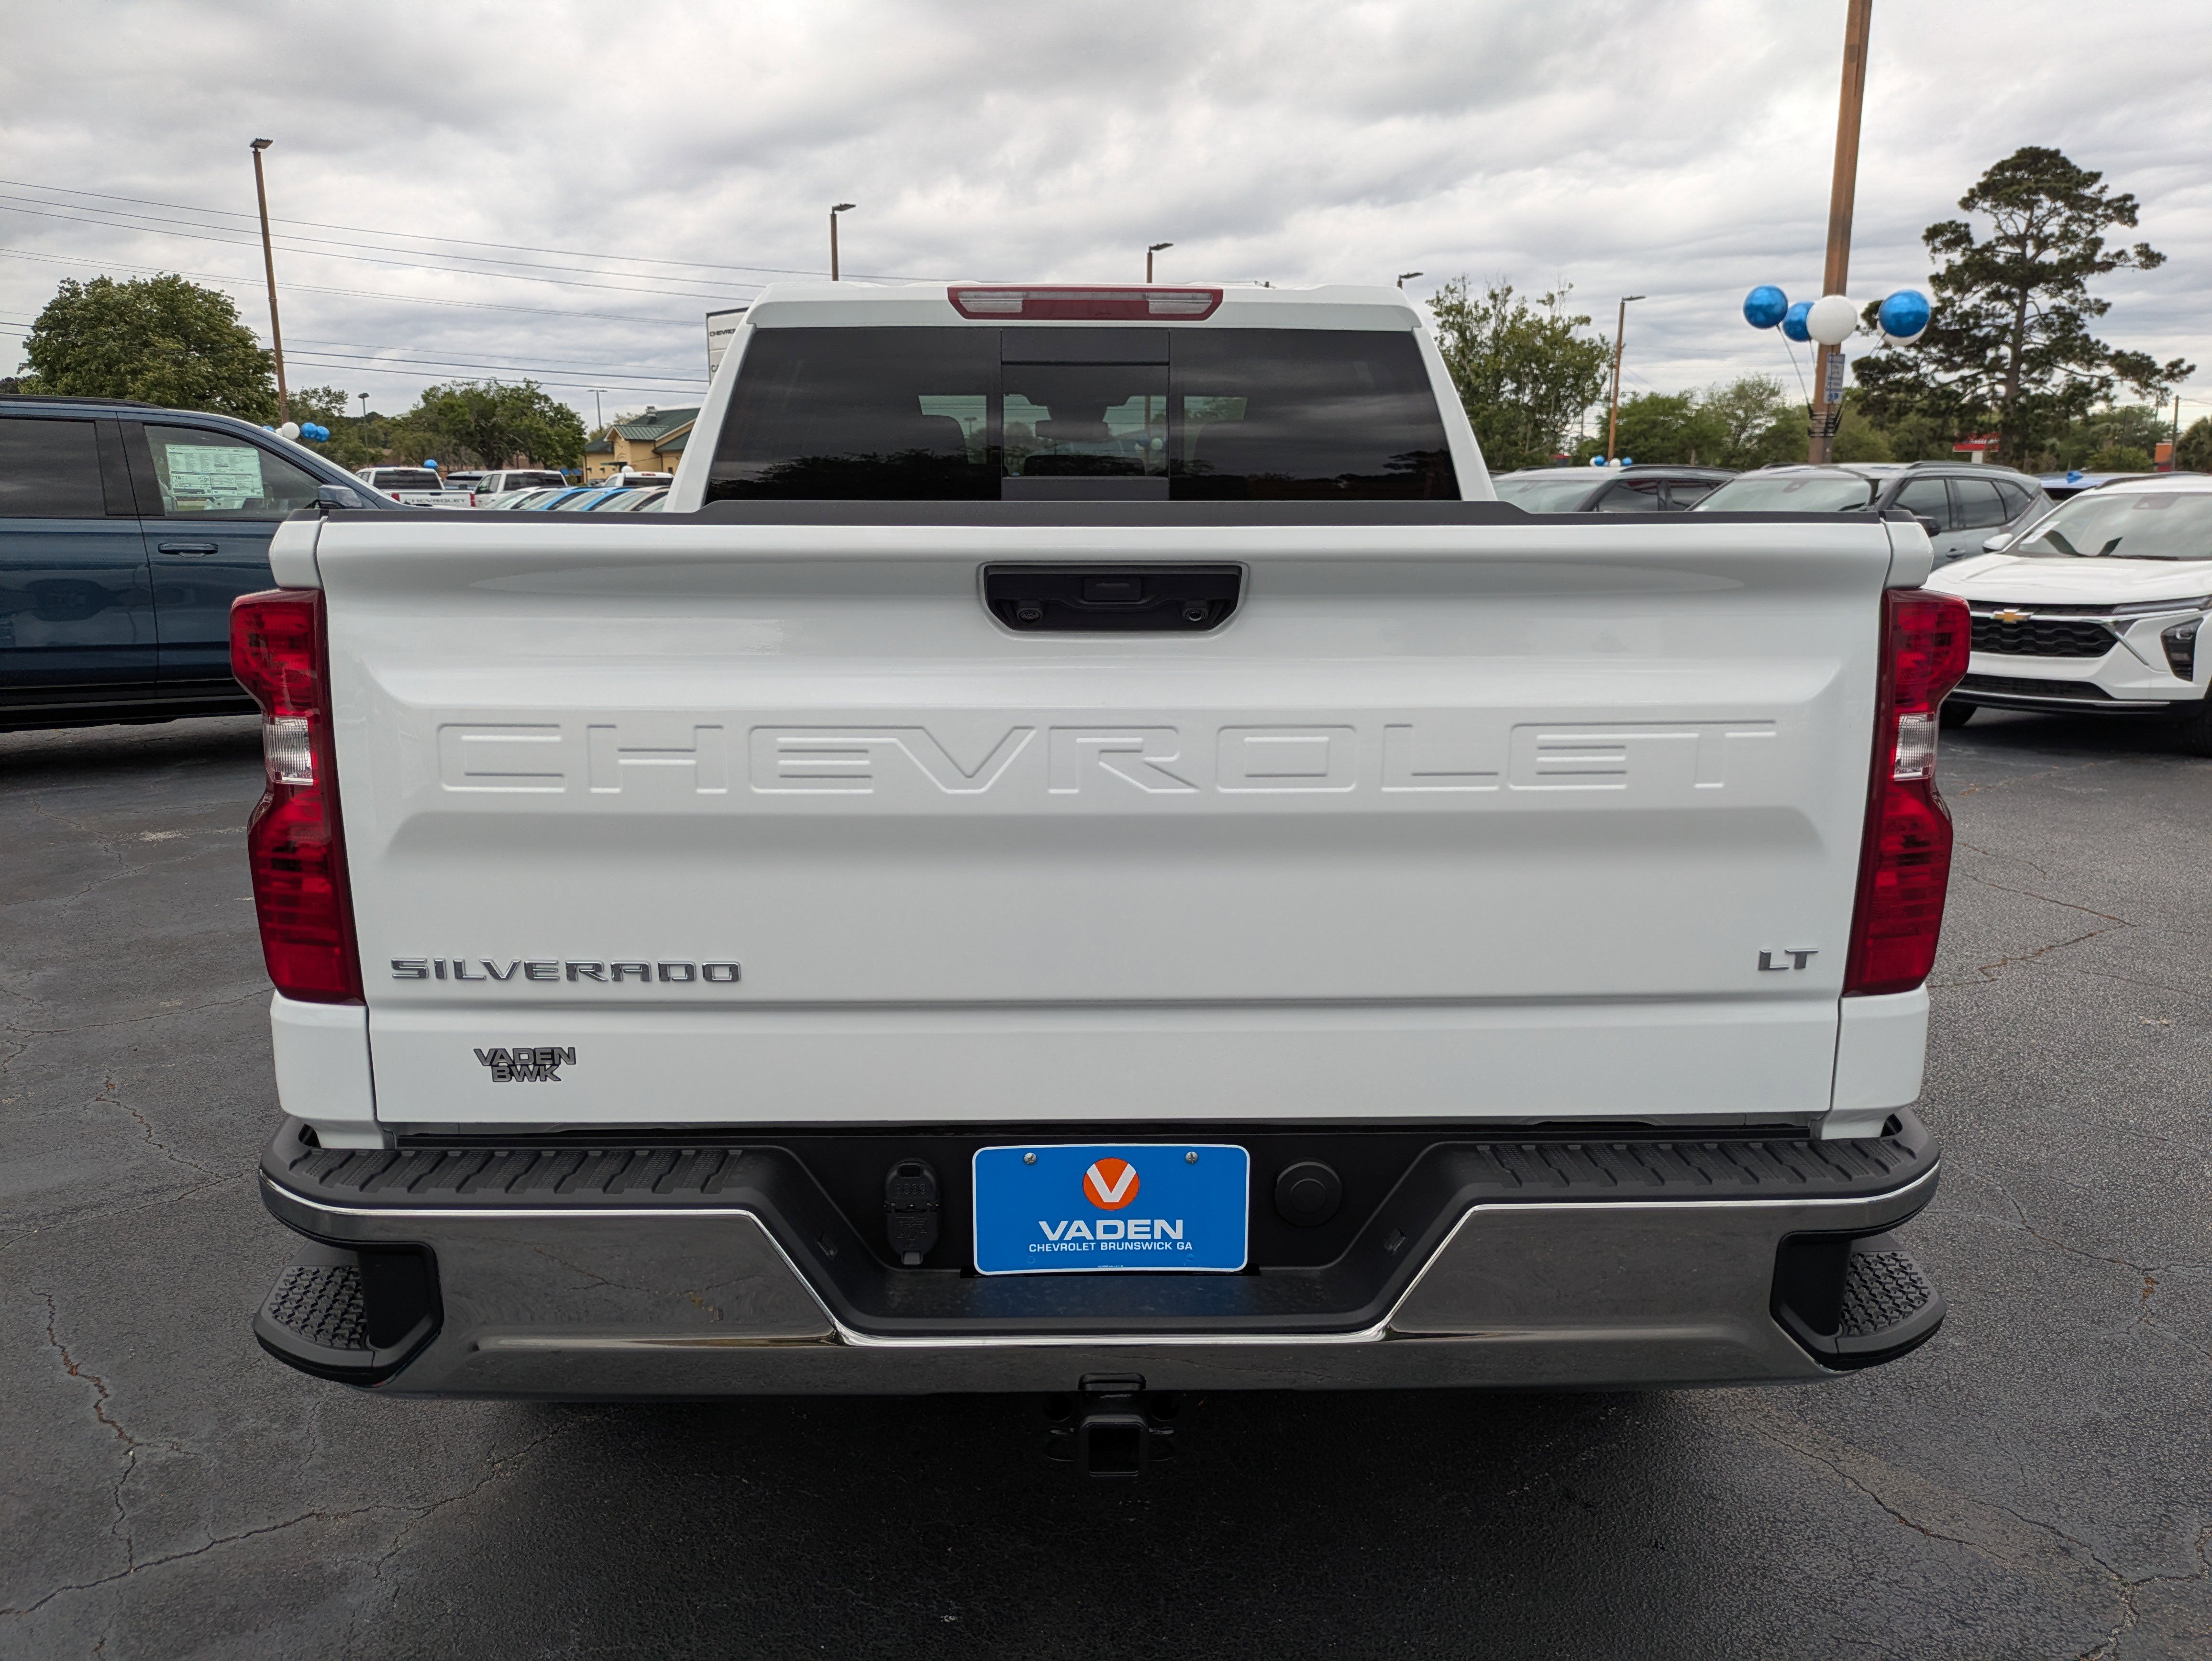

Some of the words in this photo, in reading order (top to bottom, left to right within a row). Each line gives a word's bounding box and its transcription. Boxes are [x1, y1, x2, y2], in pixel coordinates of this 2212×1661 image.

[436, 719, 1776, 795] CHEVROLET
[390, 957, 741, 982] SILVERADO
[1758, 948, 1818, 970] LT
[473, 1047, 576, 1066] VADEN
[491, 1065, 561, 1082] BWK
[1039, 1219, 1183, 1241] VADEN
[1029, 1242, 1096, 1252] CHEVROLET
[1100, 1241, 1172, 1251] BRUNSWICK
[1176, 1241, 1193, 1251] GA
